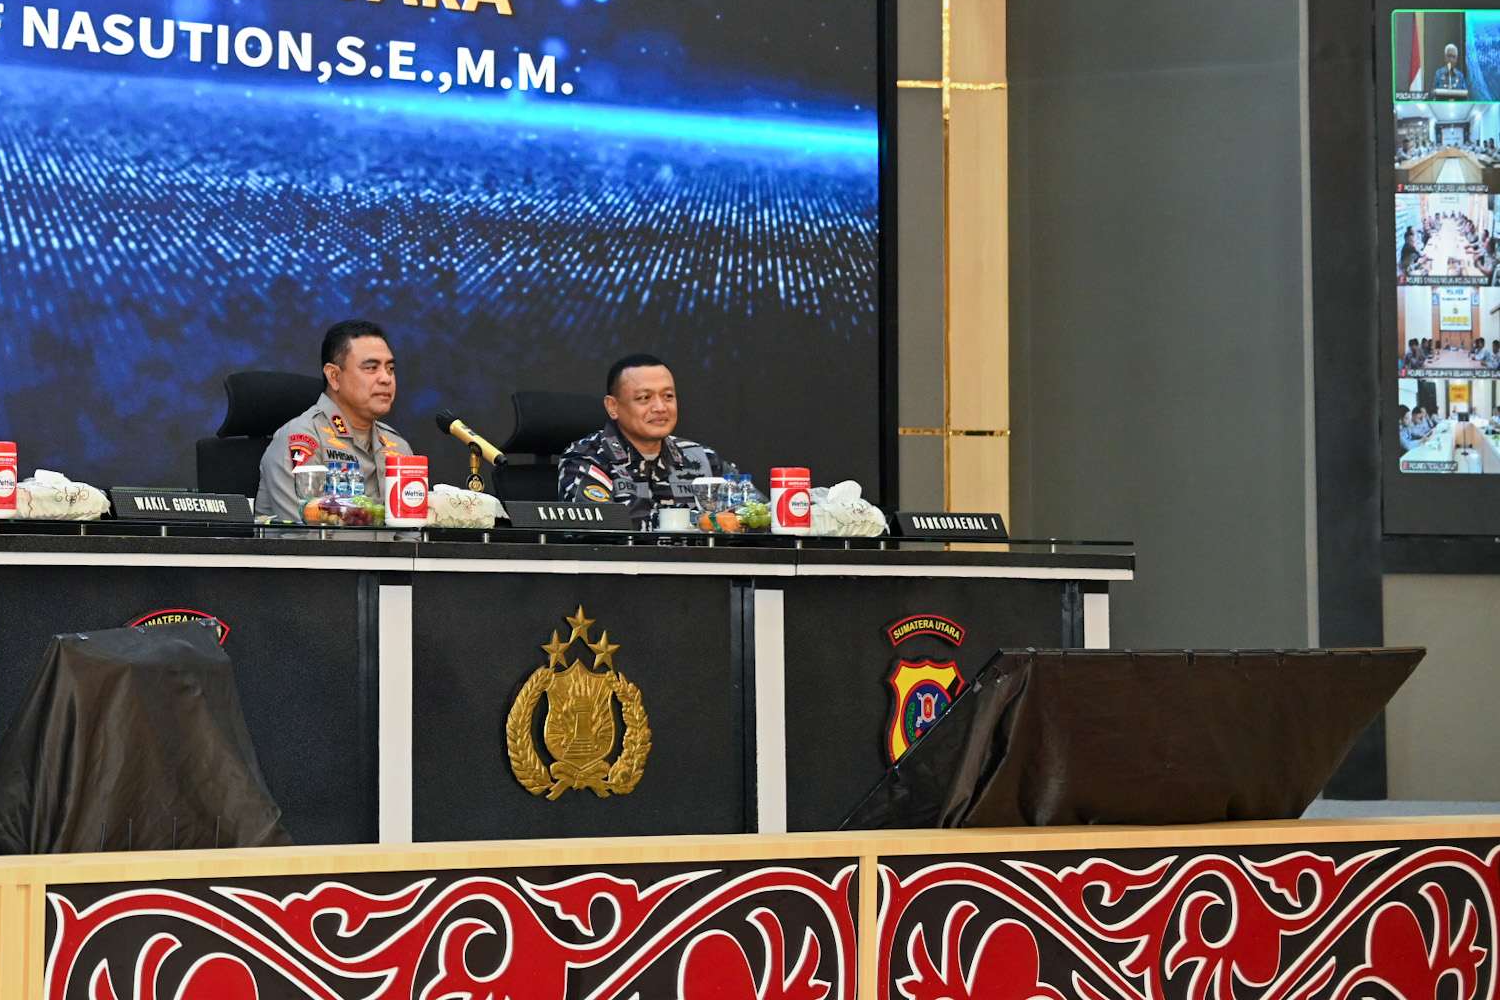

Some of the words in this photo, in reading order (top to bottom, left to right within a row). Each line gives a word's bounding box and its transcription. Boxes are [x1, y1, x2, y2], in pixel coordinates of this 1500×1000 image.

[326, 449, 359, 462] WHISNU
[133, 496, 170, 511] WAKIL
[172, 498, 228, 514] GUBERNUR
[538, 506, 604, 522] KAPOLDA
[893, 619, 934, 639] SUMATERA
[935, 621, 960, 640] UTARA
